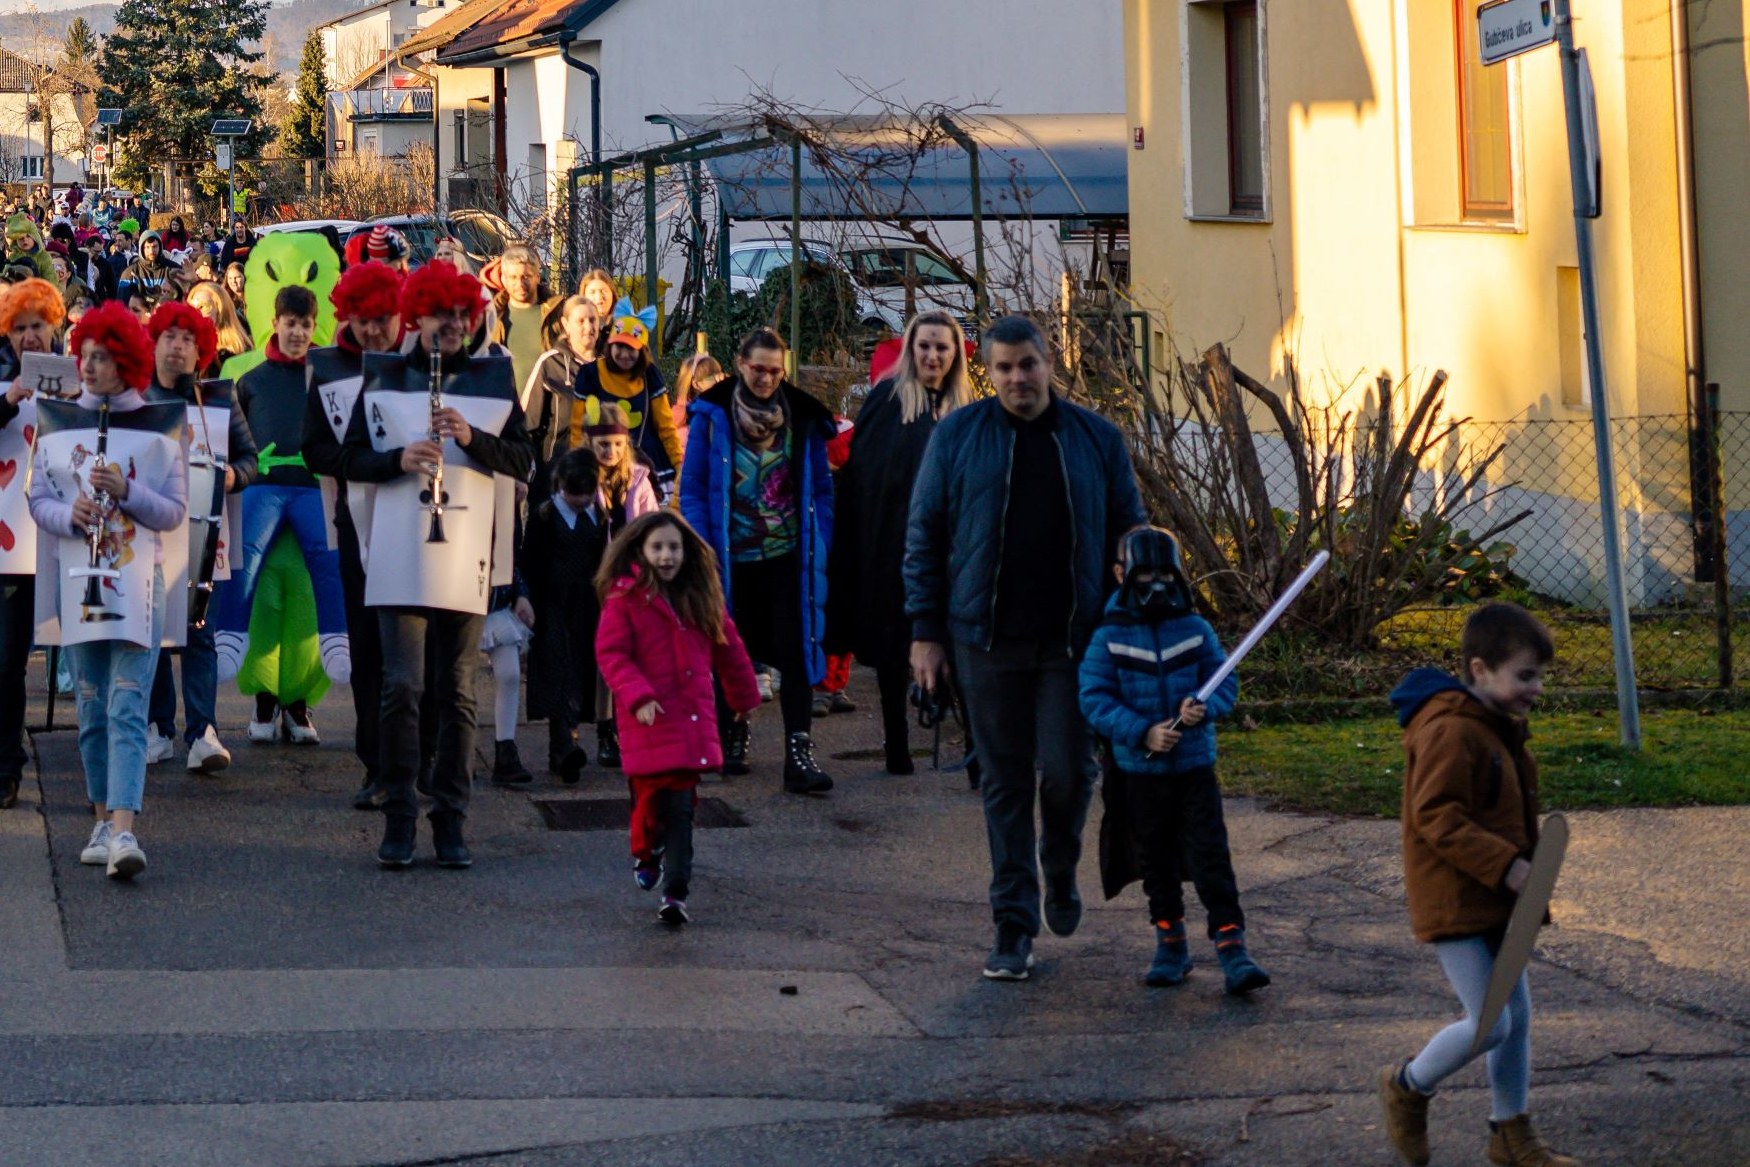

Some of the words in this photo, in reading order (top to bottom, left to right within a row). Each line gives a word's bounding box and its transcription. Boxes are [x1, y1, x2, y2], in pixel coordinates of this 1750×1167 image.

[1516, 18, 1533, 38] ulica
[325, 390, 340, 413] K
[371, 401, 384, 423] A
